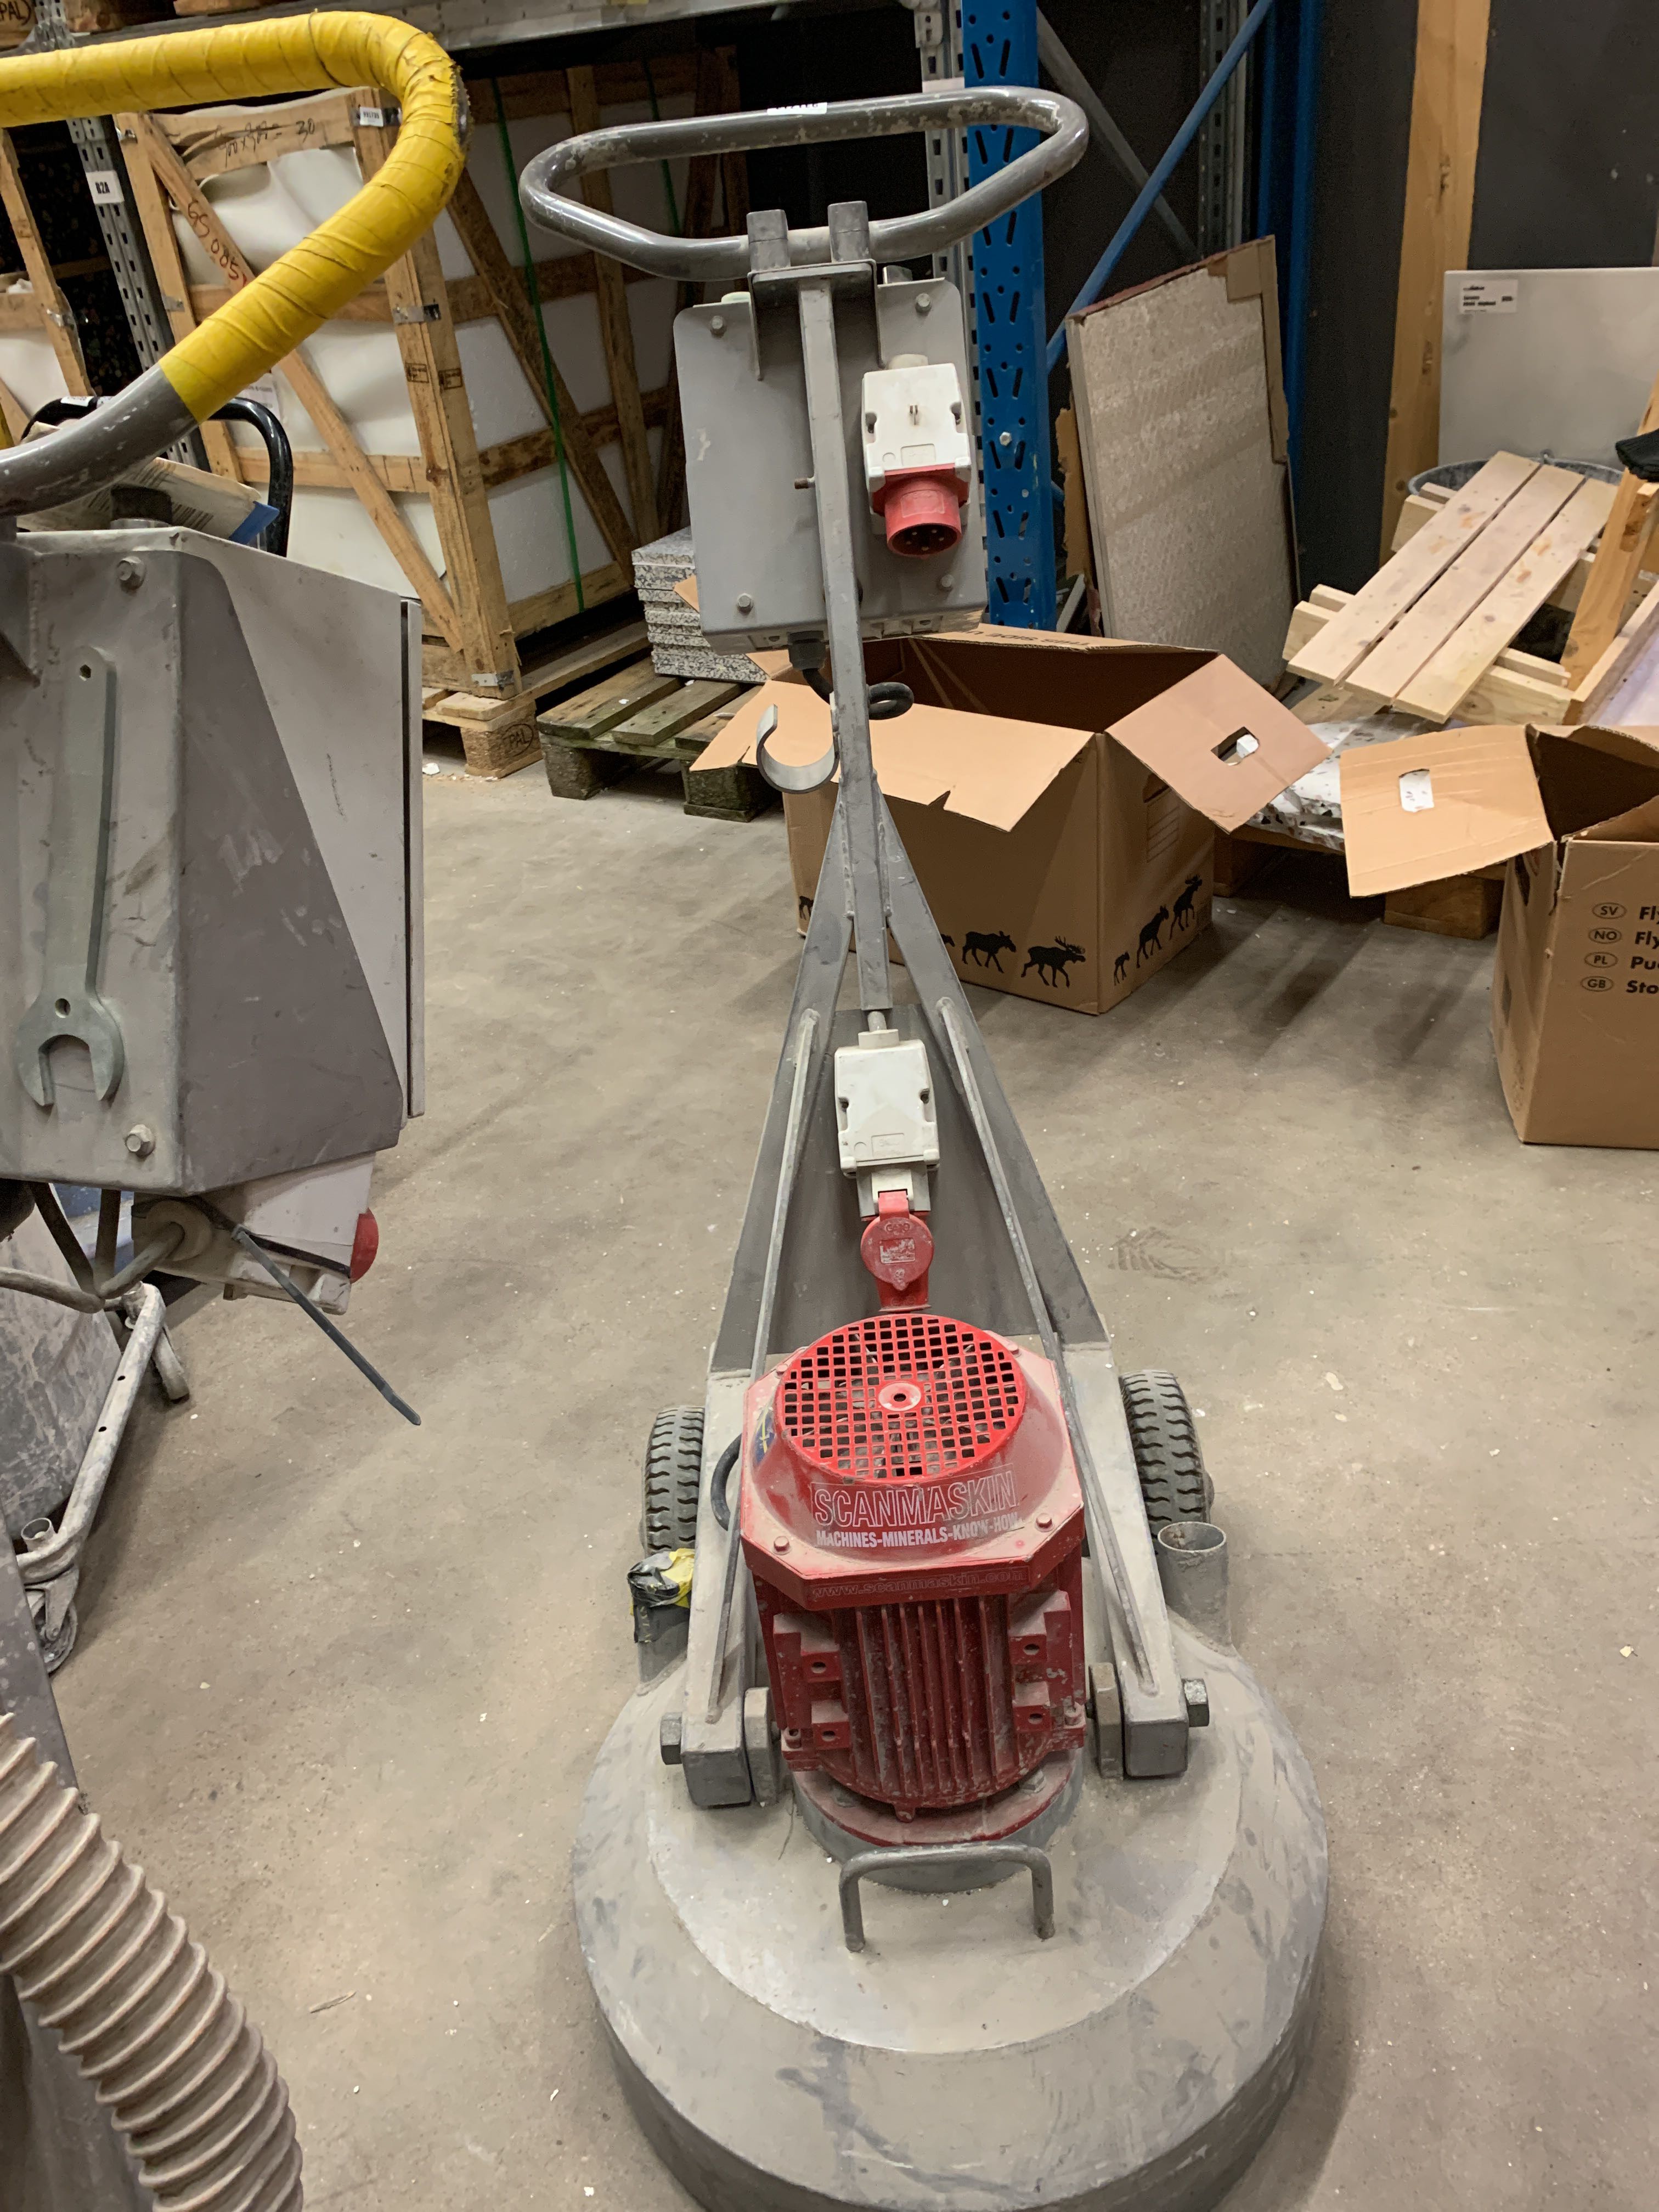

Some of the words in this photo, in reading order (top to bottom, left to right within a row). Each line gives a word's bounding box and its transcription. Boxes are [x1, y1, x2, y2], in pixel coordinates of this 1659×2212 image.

[986, 633, 1037, 641] SIDE
[1600, 906, 1618, 916] SV
[1594, 931, 1617, 940] NO
[1594, 955, 1608, 964] PL
[1630, 956, 1659, 970] Pu
[1587, 979, 1606, 988] GB
[815, 1470, 1017, 1527] SCANMASKIN
[813, 1571, 1025, 1598] www.scanmaskin.com
